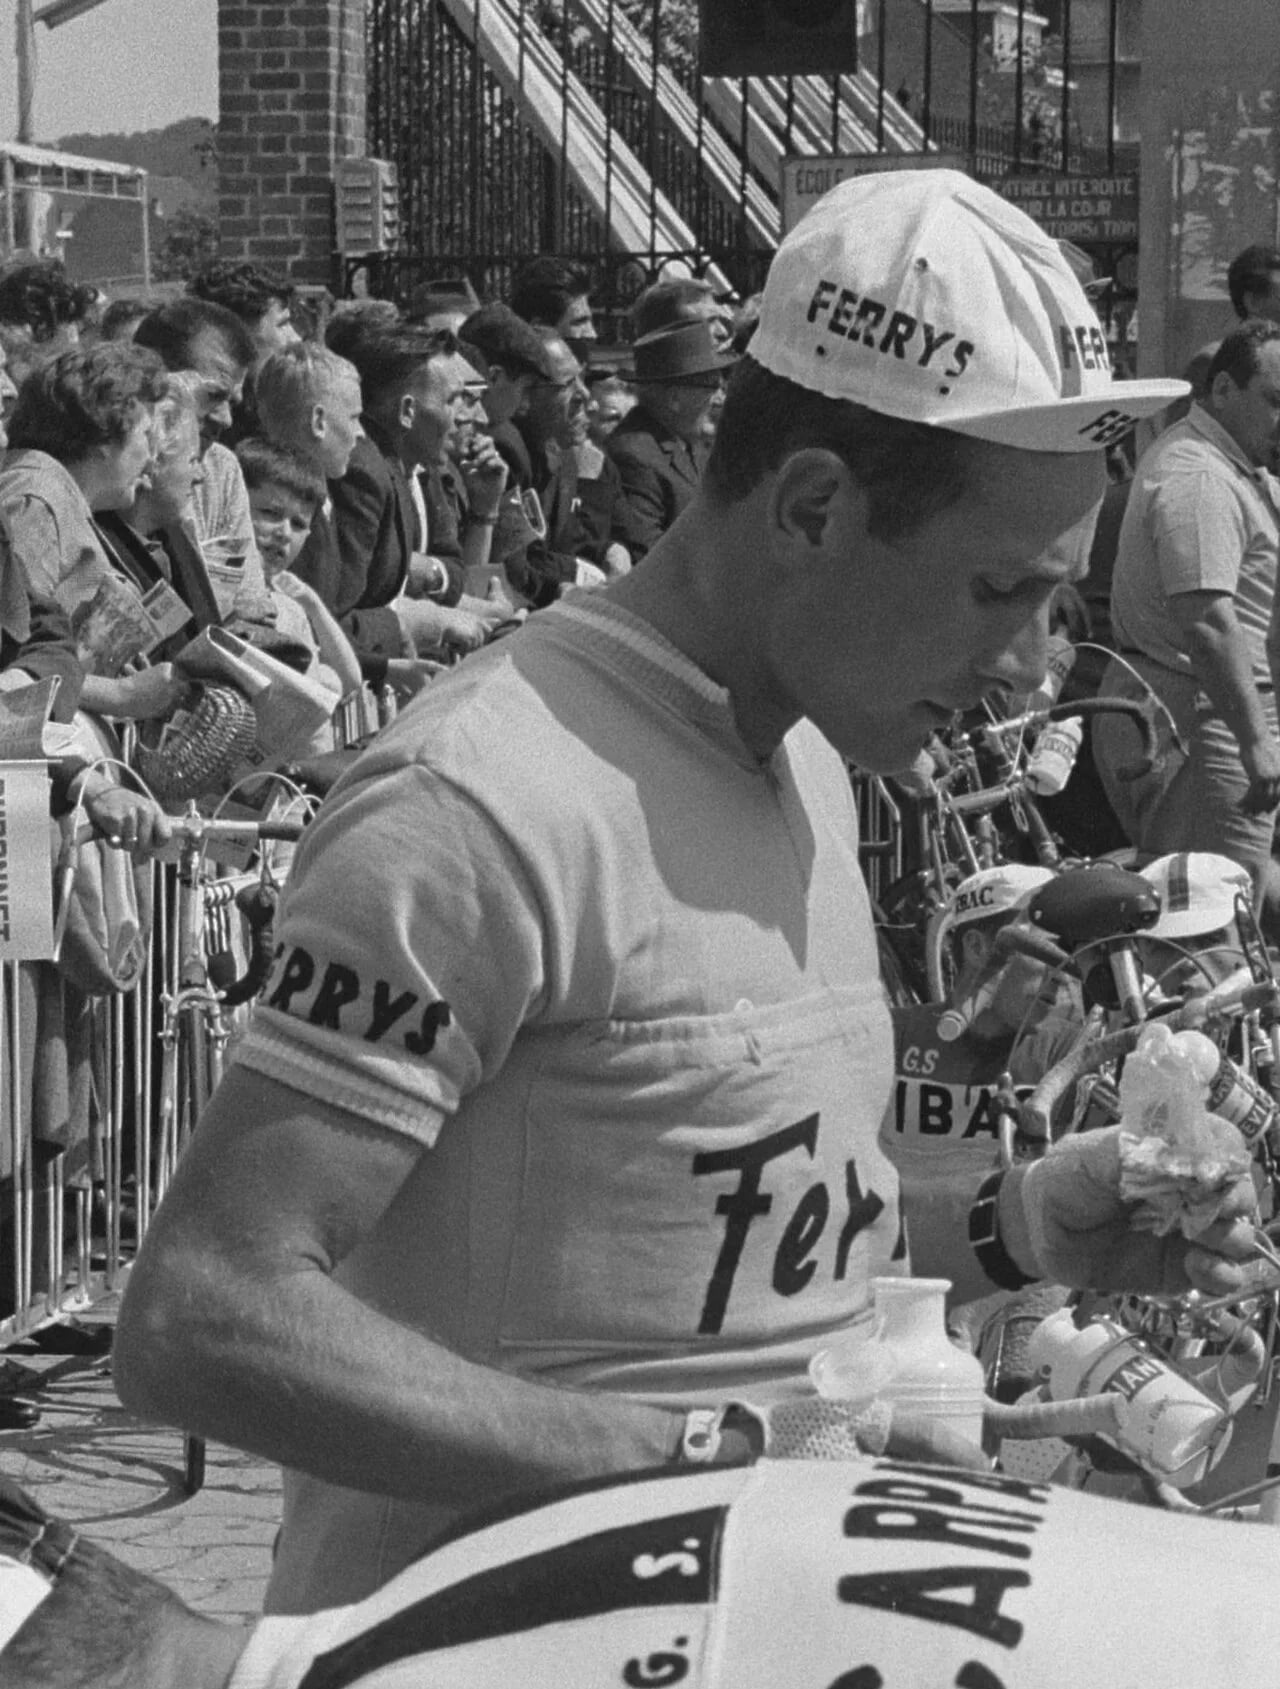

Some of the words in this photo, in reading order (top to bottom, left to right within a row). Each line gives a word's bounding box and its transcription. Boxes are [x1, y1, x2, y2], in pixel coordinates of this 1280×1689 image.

[1047, 200, 1067, 217] LA
[807, 280, 975, 377] FERRYS
[260, 942, 450, 1055] RRYS
[692, 1111, 906, 1334] Fer
